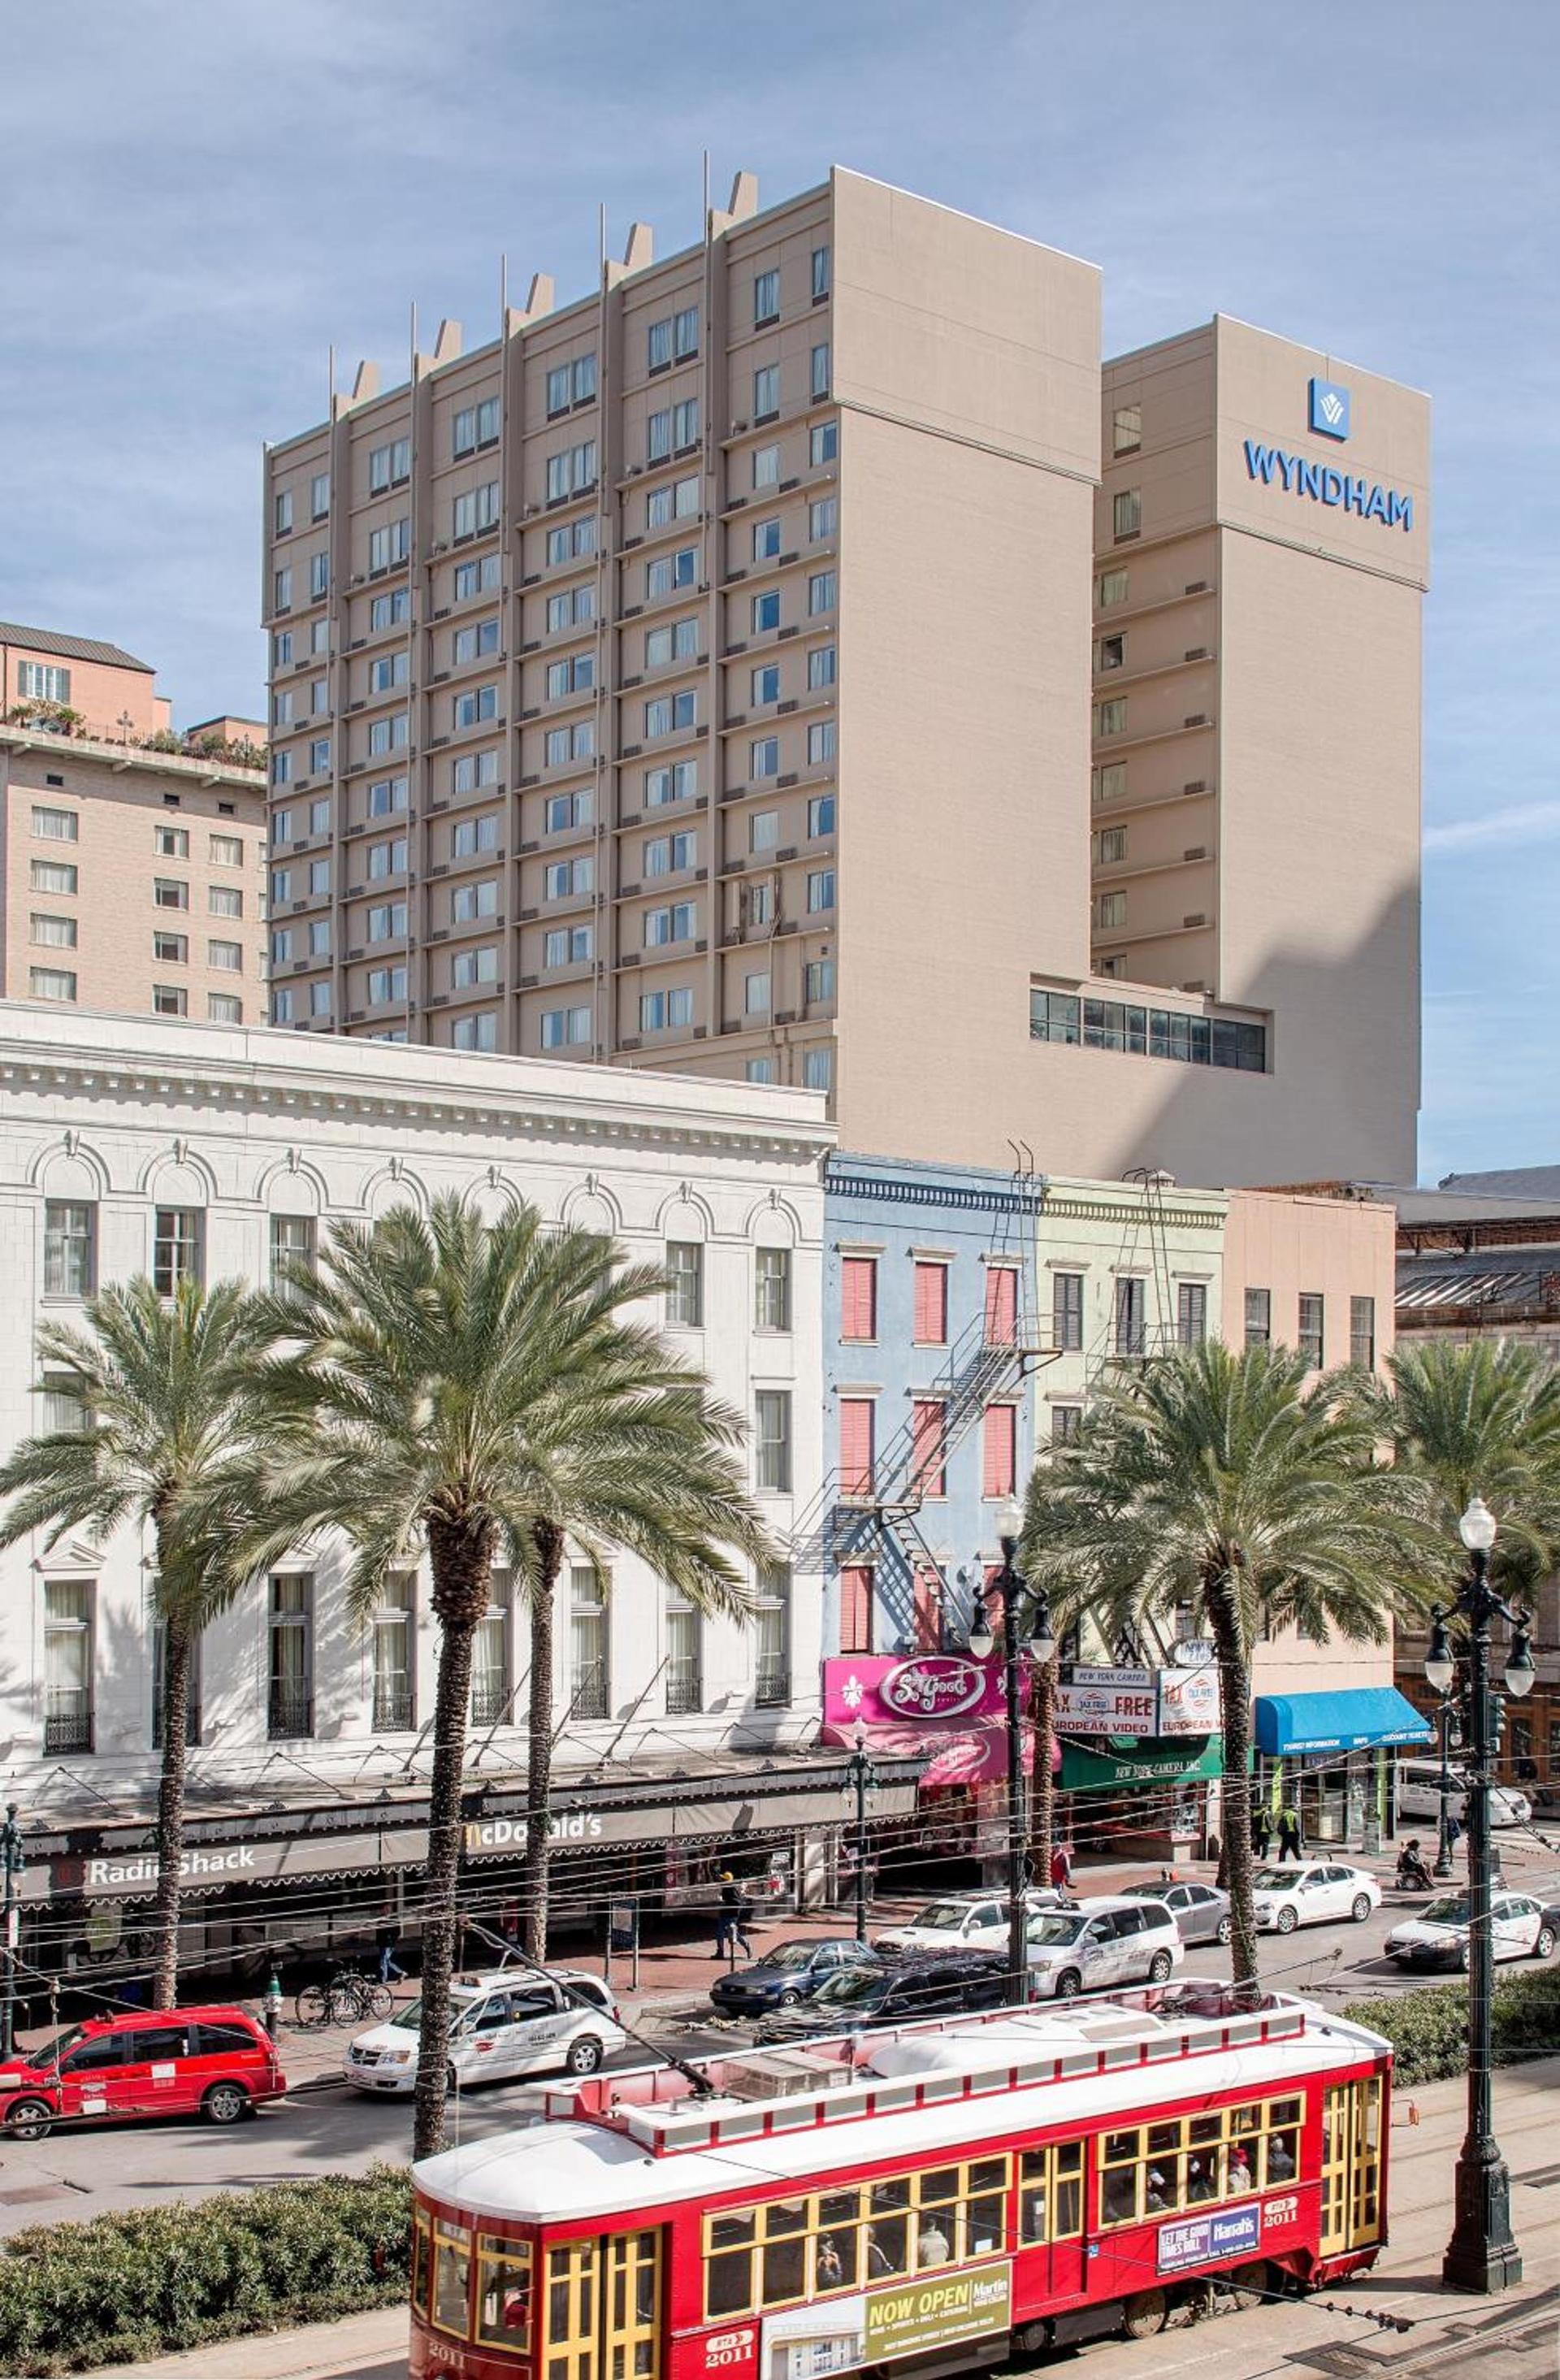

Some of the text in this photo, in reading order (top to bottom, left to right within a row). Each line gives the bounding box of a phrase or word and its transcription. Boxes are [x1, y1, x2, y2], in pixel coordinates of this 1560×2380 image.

[1244, 439, 1413, 532] WYNDHAM
[1115, 1696, 1153, 1716] FREE
[1112, 1723, 1148, 1733] VIDEO
[1163, 1719, 1212, 1732] EUROPEAN
[90, 1845, 255, 1886] RadiShack
[1213, 2217, 1254, 2242] Harrah's
[1263, 2209, 1298, 2228] 2011
[973, 2278, 1008, 2300] Martin
[869, 2282, 969, 2328] NOW OPEN
[429, 2341, 466, 2369] 2011
[705, 2345, 754, 2368] 2011
